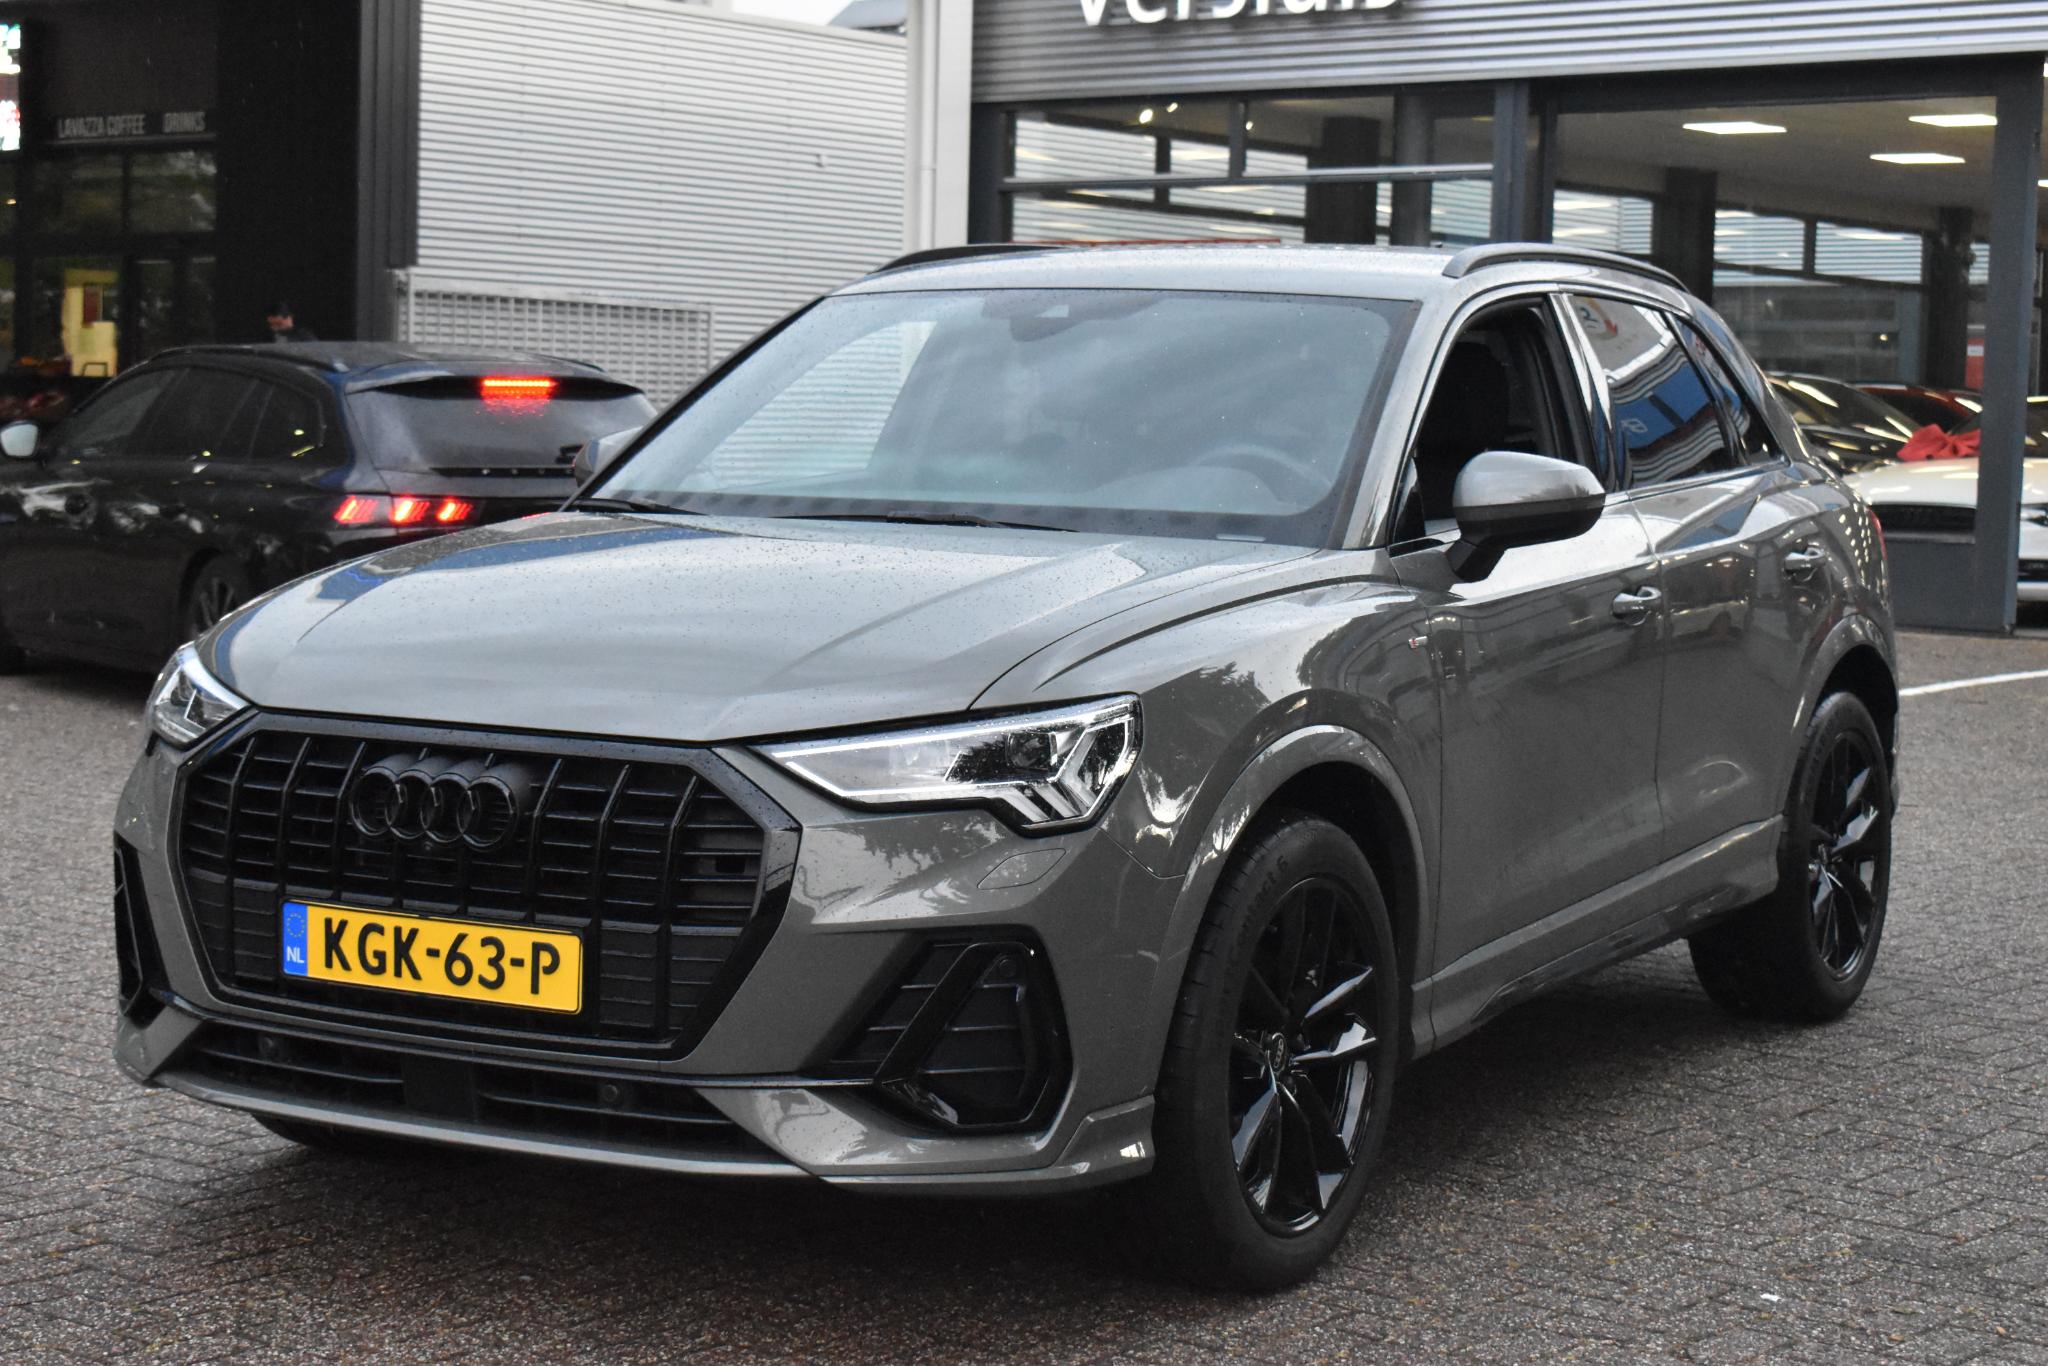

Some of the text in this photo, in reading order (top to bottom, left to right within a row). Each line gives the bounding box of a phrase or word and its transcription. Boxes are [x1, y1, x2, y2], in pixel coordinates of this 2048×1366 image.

[107, 114, 146, 136] COFFEE
[163, 111, 206, 133] DRINKS
[286, 945, 305, 964] NL
[323, 916, 561, 995] KGK-63-P
